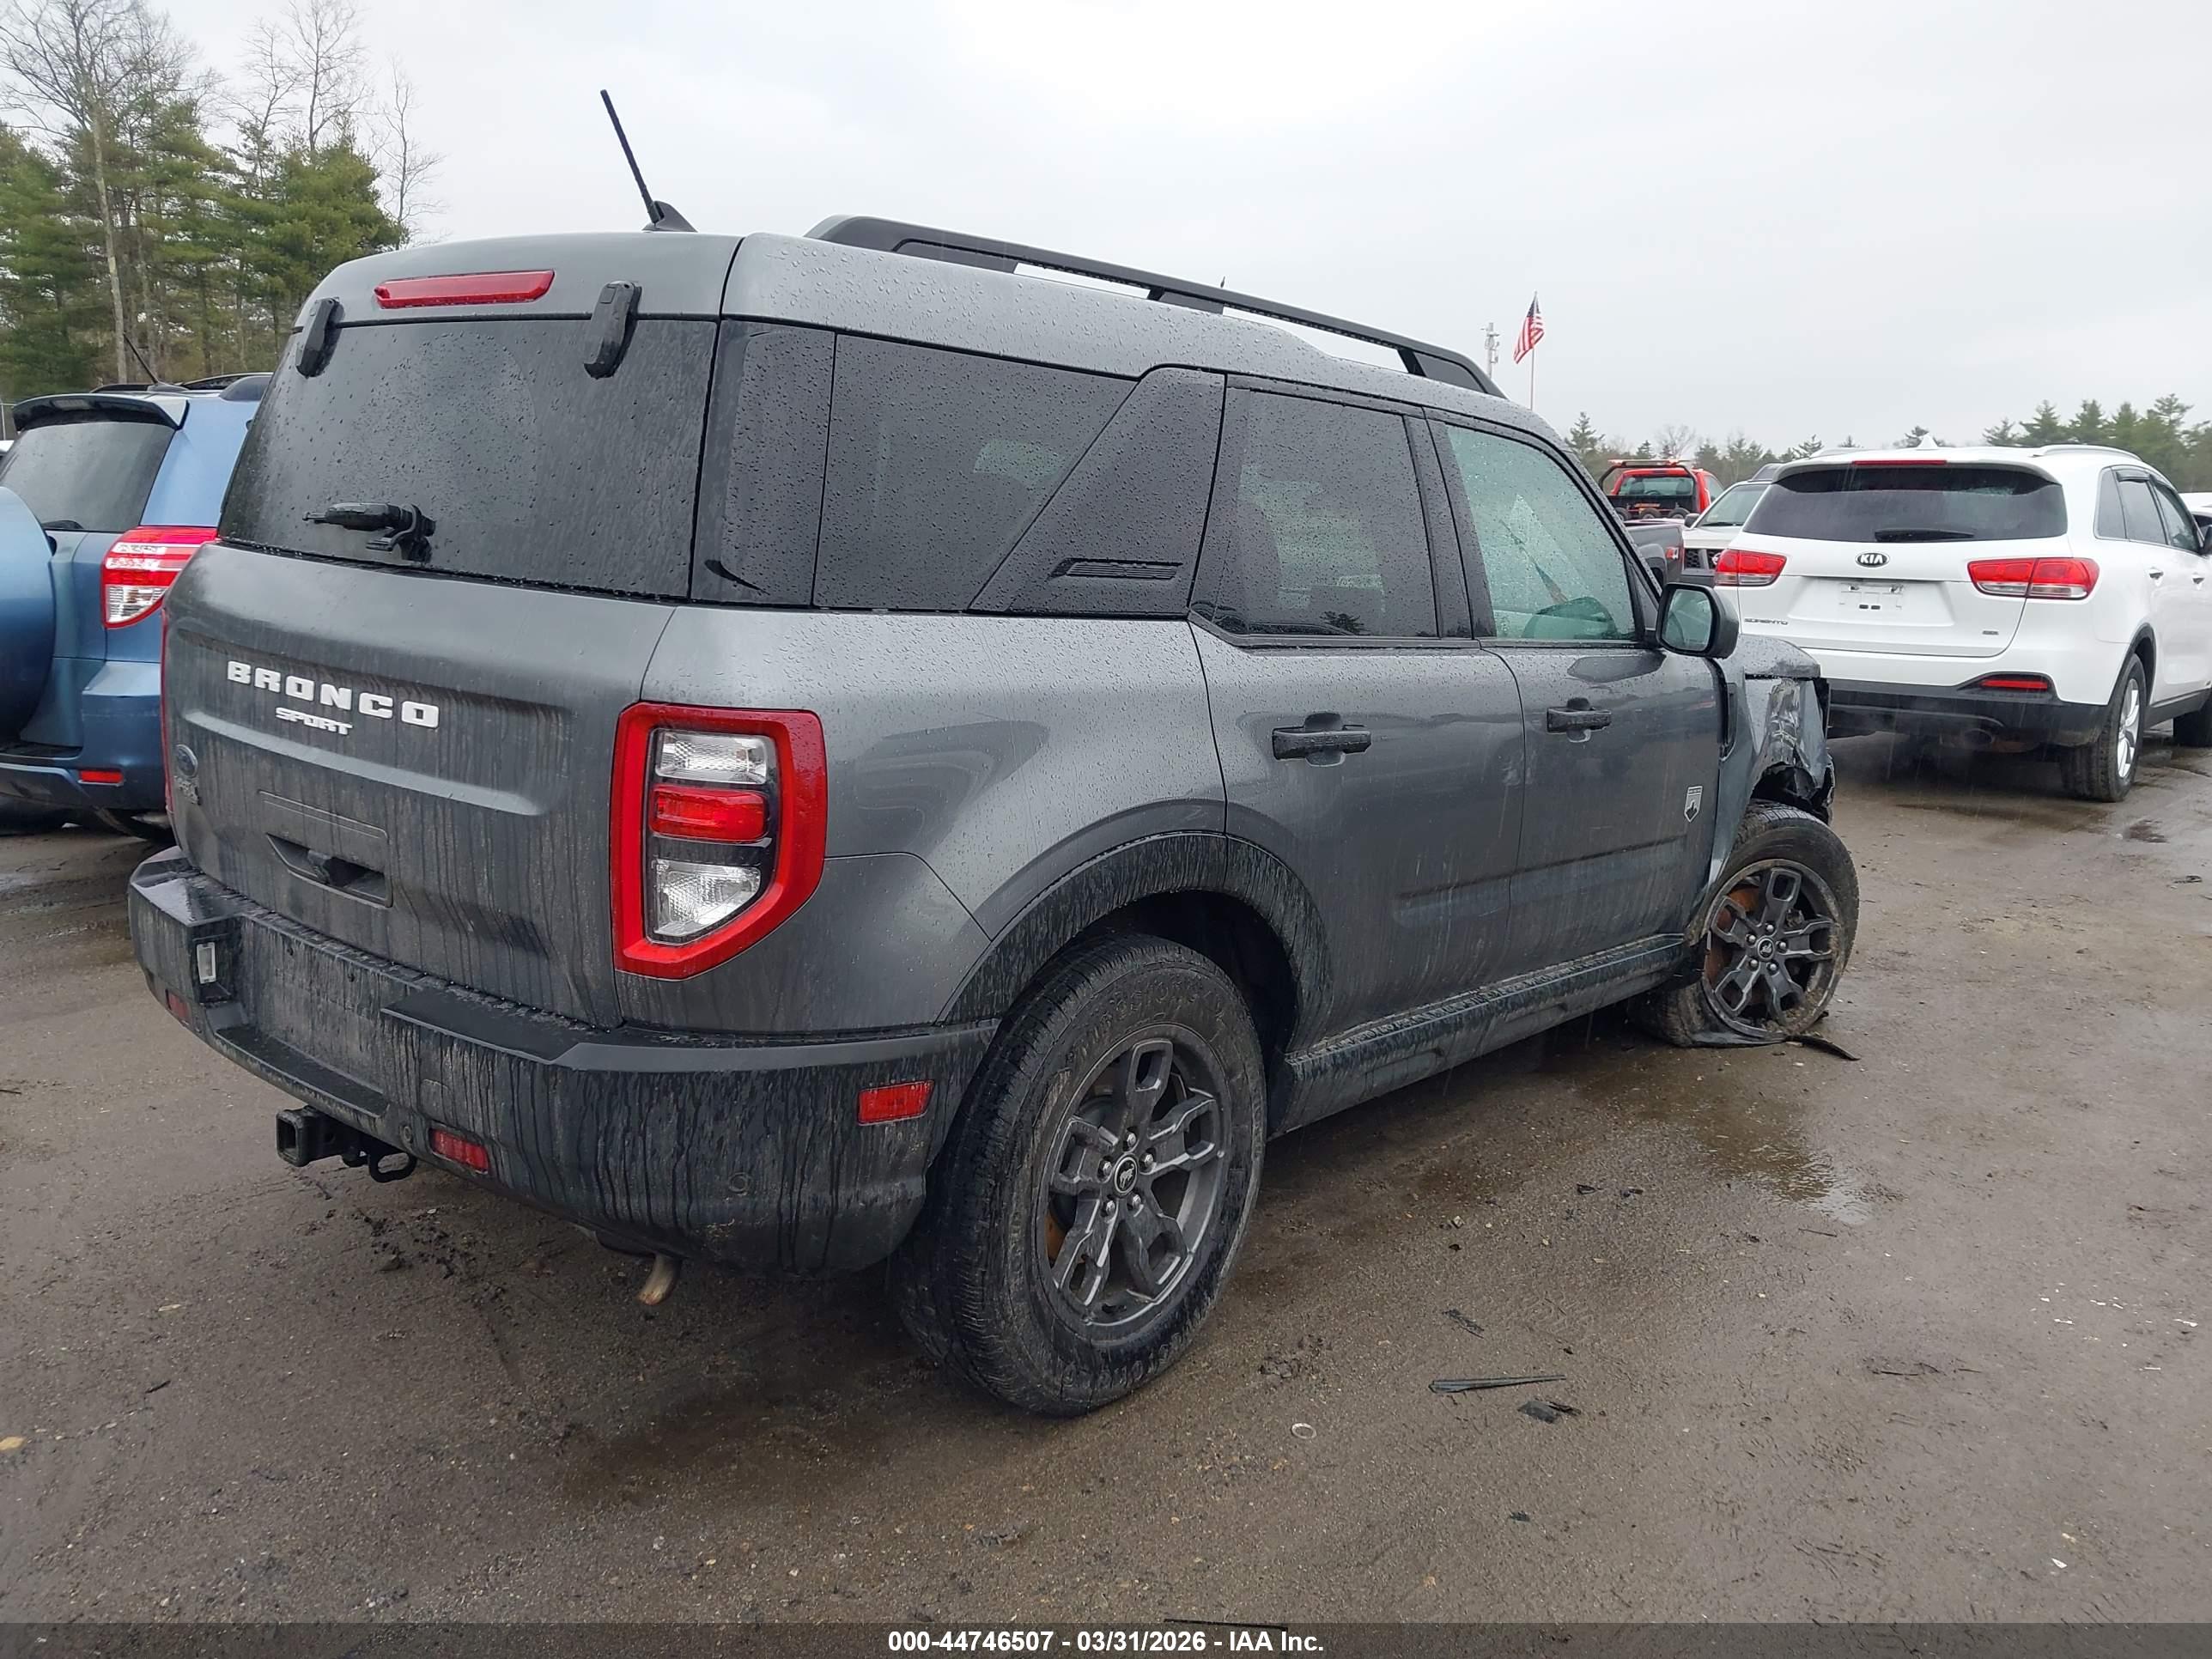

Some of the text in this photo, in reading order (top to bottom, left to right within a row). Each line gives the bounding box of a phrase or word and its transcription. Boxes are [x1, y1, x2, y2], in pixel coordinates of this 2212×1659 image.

[1860, 554, 1883, 564] KIA
[227, 660, 440, 729] BRONCO
[275, 707, 353, 736] SPORT
